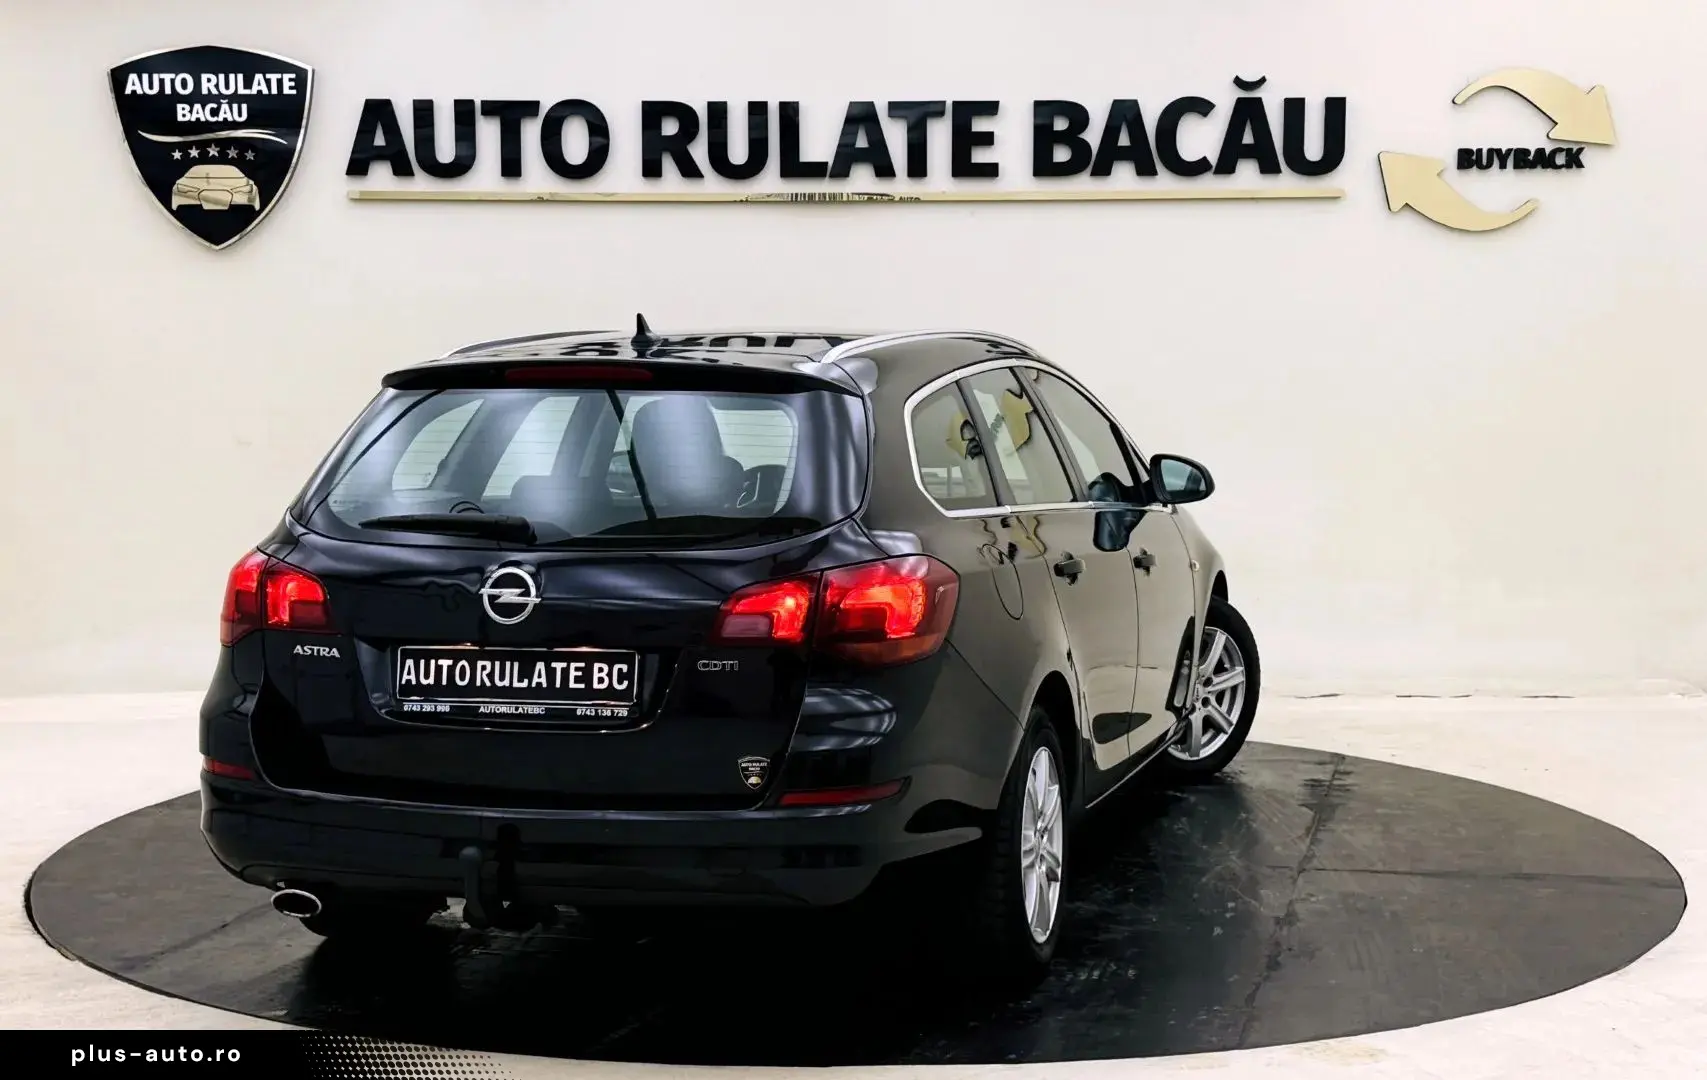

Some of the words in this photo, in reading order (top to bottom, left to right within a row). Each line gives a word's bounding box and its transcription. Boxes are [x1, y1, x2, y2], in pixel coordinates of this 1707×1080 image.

[124, 72, 194, 95] AUTO
[200, 73, 297, 95] RULATE
[176, 99, 248, 122] BACĂU
[346, 98, 611, 180] AUTO
[641, 100, 1001, 180] RULATE
[1032, 75, 1348, 177] BACĂU
[1456, 146, 1586, 170] BUYBACK
[293, 644, 341, 658] ASTRA
[592, 662, 629, 690] BC
[697, 660, 739, 671] CDTI
[478, 705, 546, 714] AUTORULATEBC
[576, 708, 595, 717] 0743
